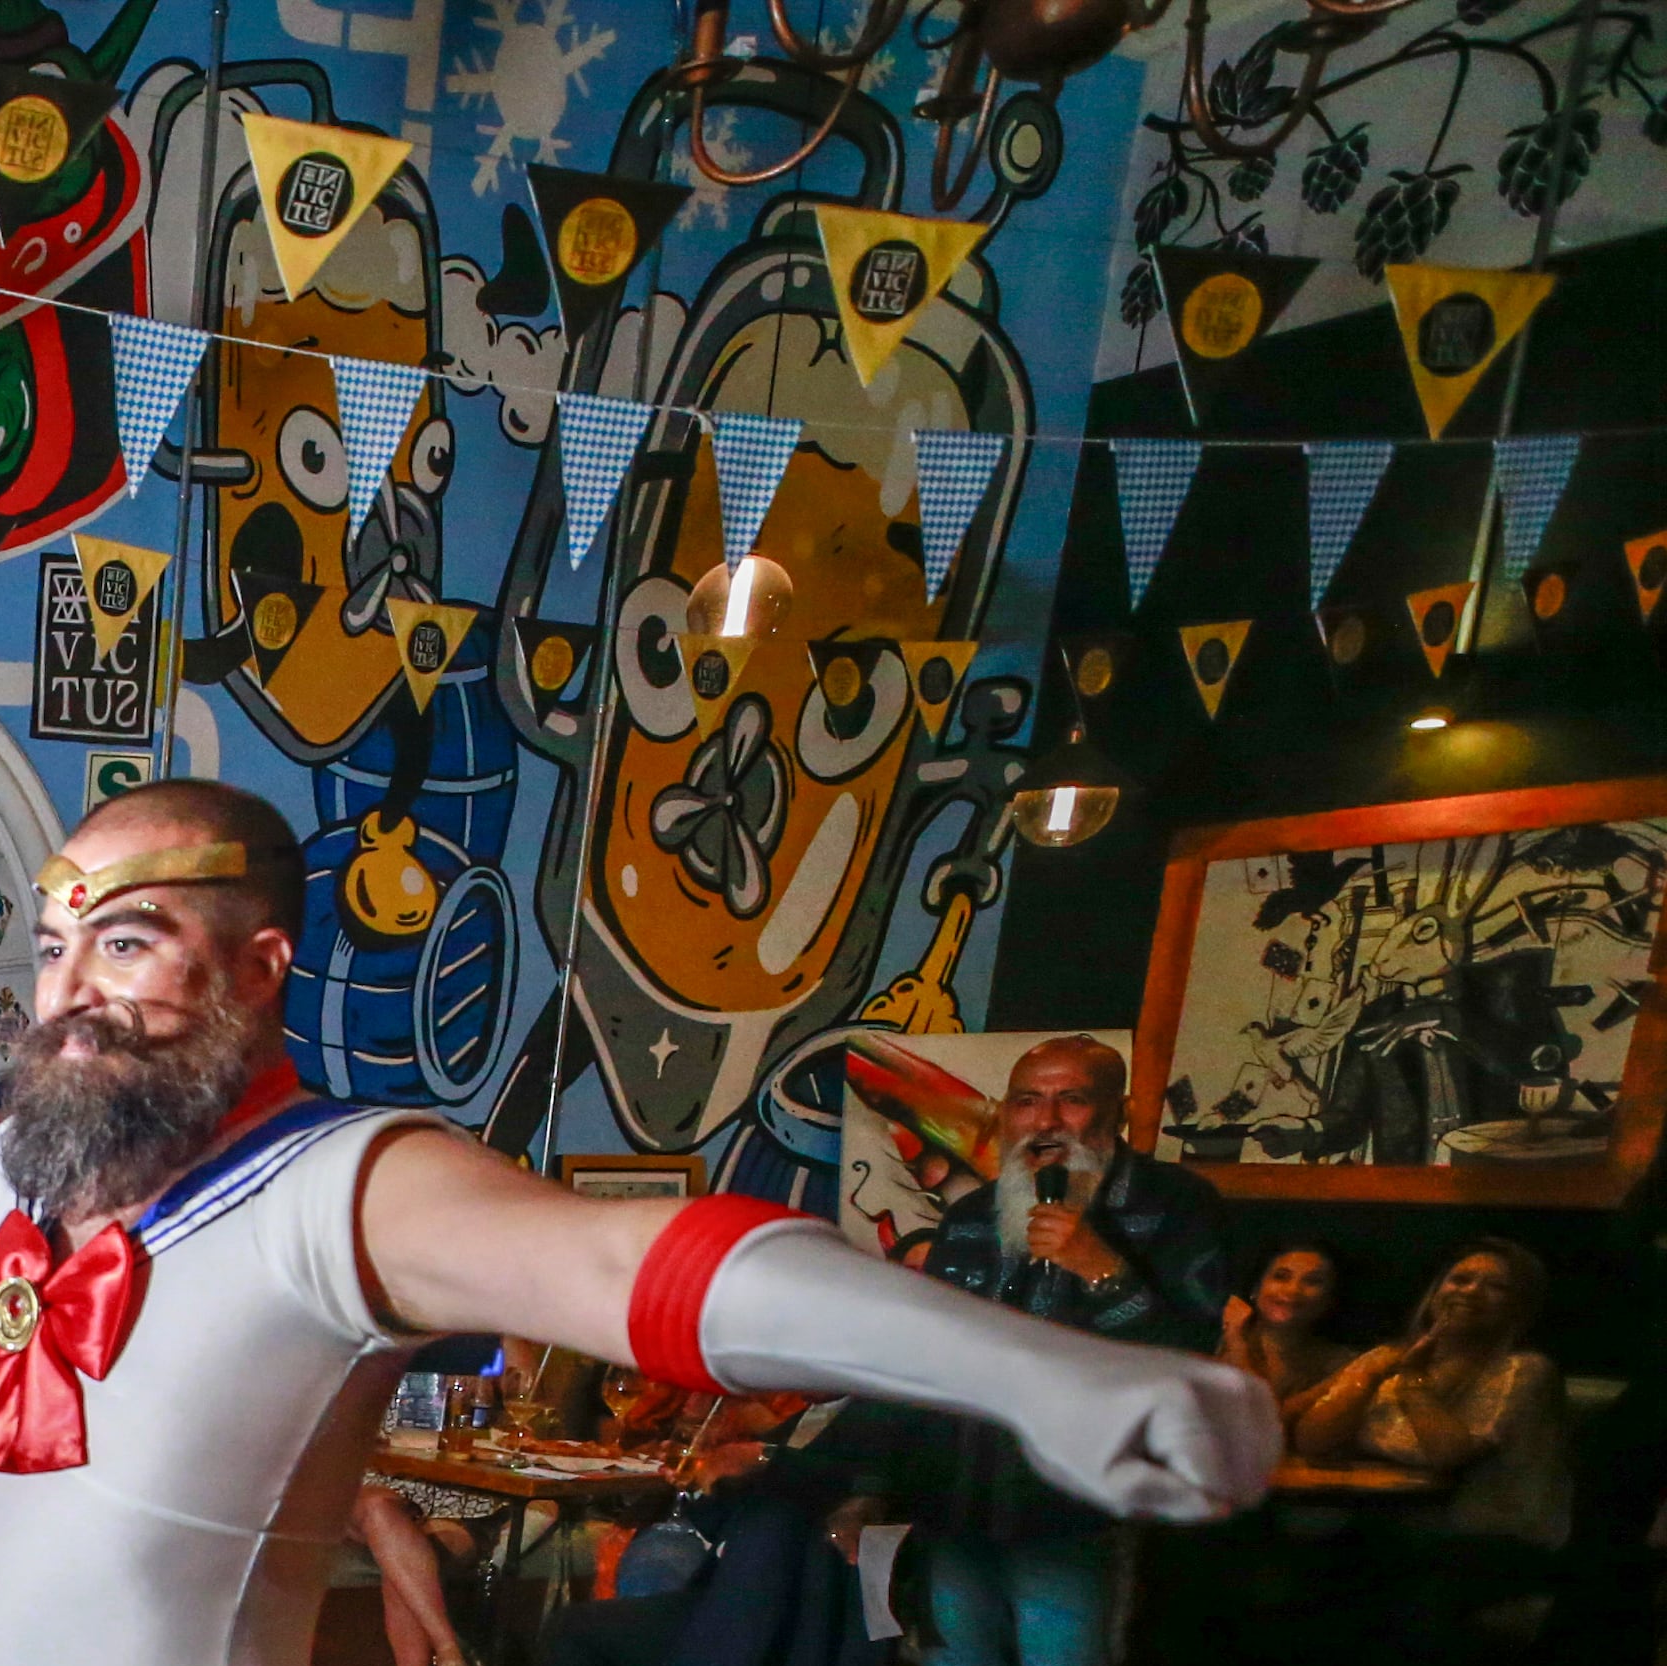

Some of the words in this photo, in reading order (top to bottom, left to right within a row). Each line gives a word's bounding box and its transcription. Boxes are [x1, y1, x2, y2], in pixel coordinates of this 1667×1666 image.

[299, 182, 334, 206] VIC
[292, 201, 328, 224] TUS
[51, 676, 139, 728] TUS
[97, 760, 141, 799] S
